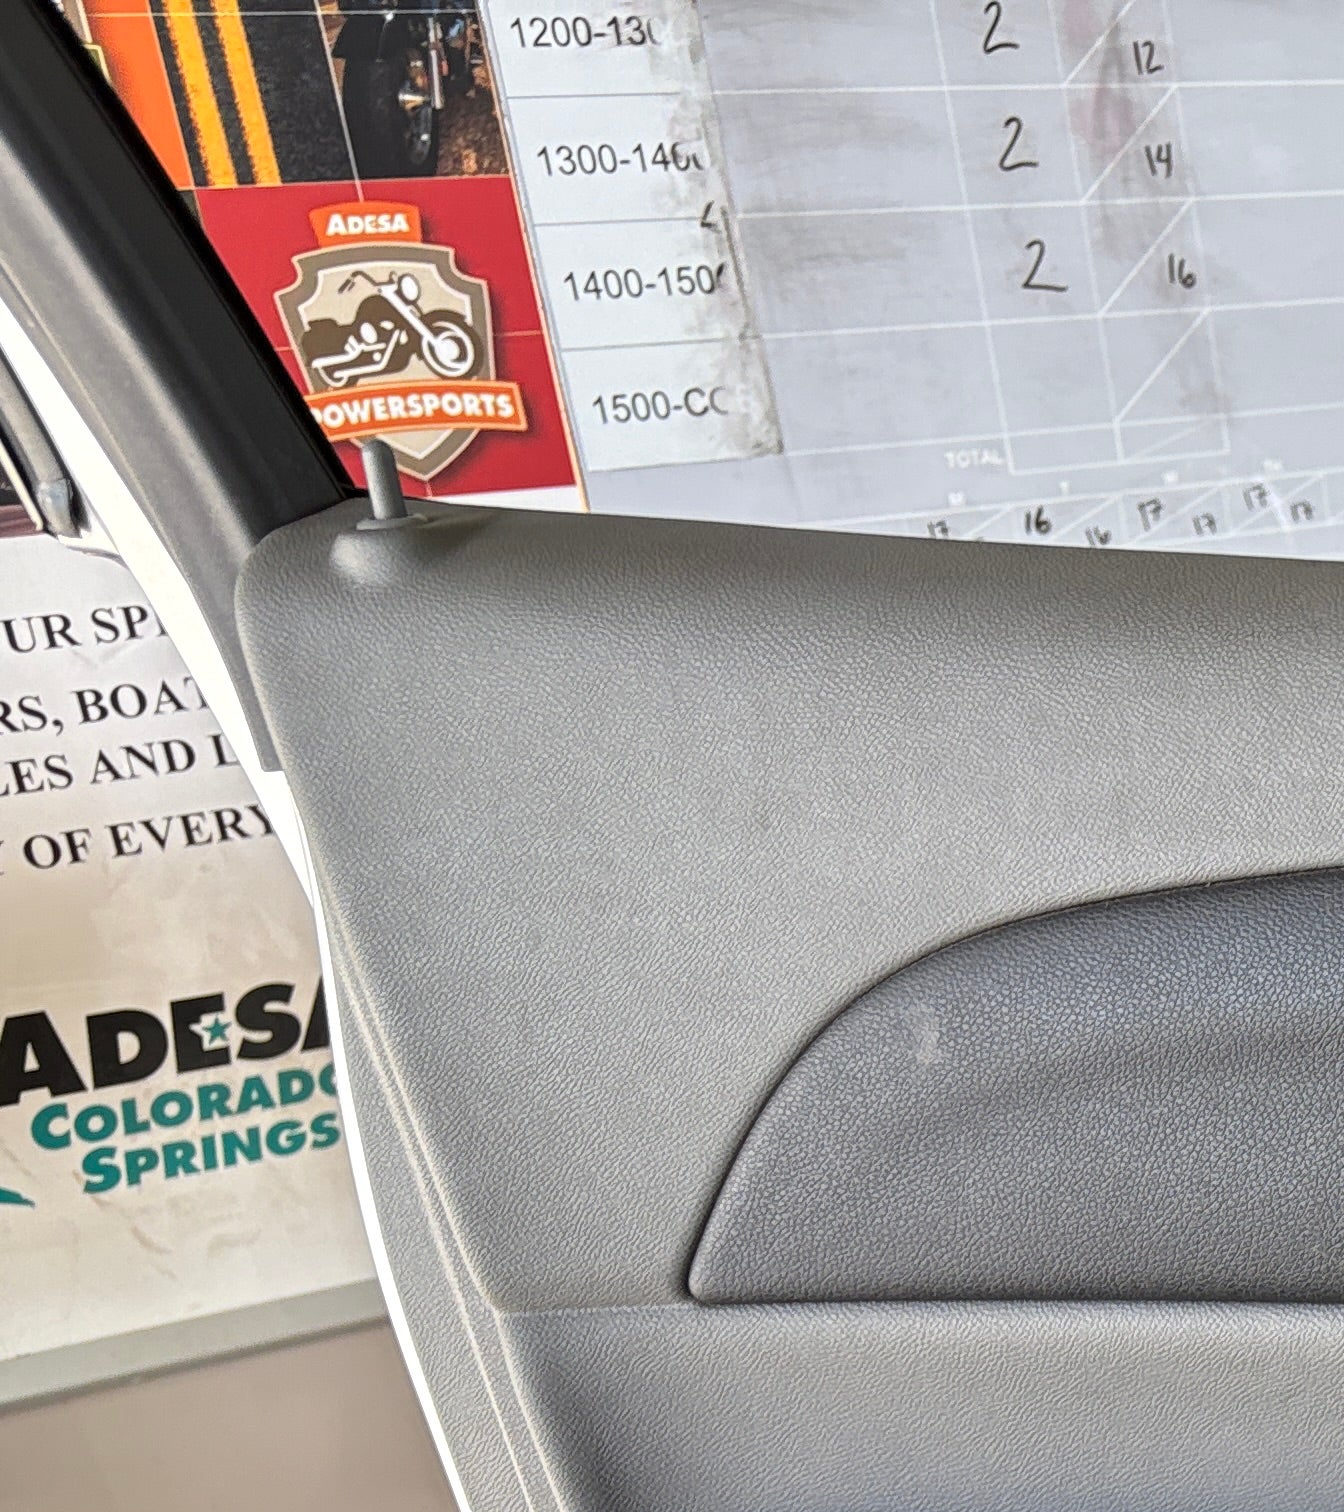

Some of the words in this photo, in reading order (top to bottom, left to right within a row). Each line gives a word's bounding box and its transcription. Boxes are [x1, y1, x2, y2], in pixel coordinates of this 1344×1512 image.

[983, 0, 1019, 54] 2
[1133, 41, 1164, 76] 12
[999, 116, 1039, 172] 2
[1145, 142, 1172, 179] 14
[326, 213, 410, 236] ADESA
[1021, 240, 1068, 293] 2
[1168, 253, 1197, 289] 16
[944, 448, 1003, 469] TOTAL
[1024, 505, 1052, 537] 16
[90, 738, 196, 785] AND
[23, 827, 92, 870] OF
[82, 1111, 340, 1195] SPRINGS
